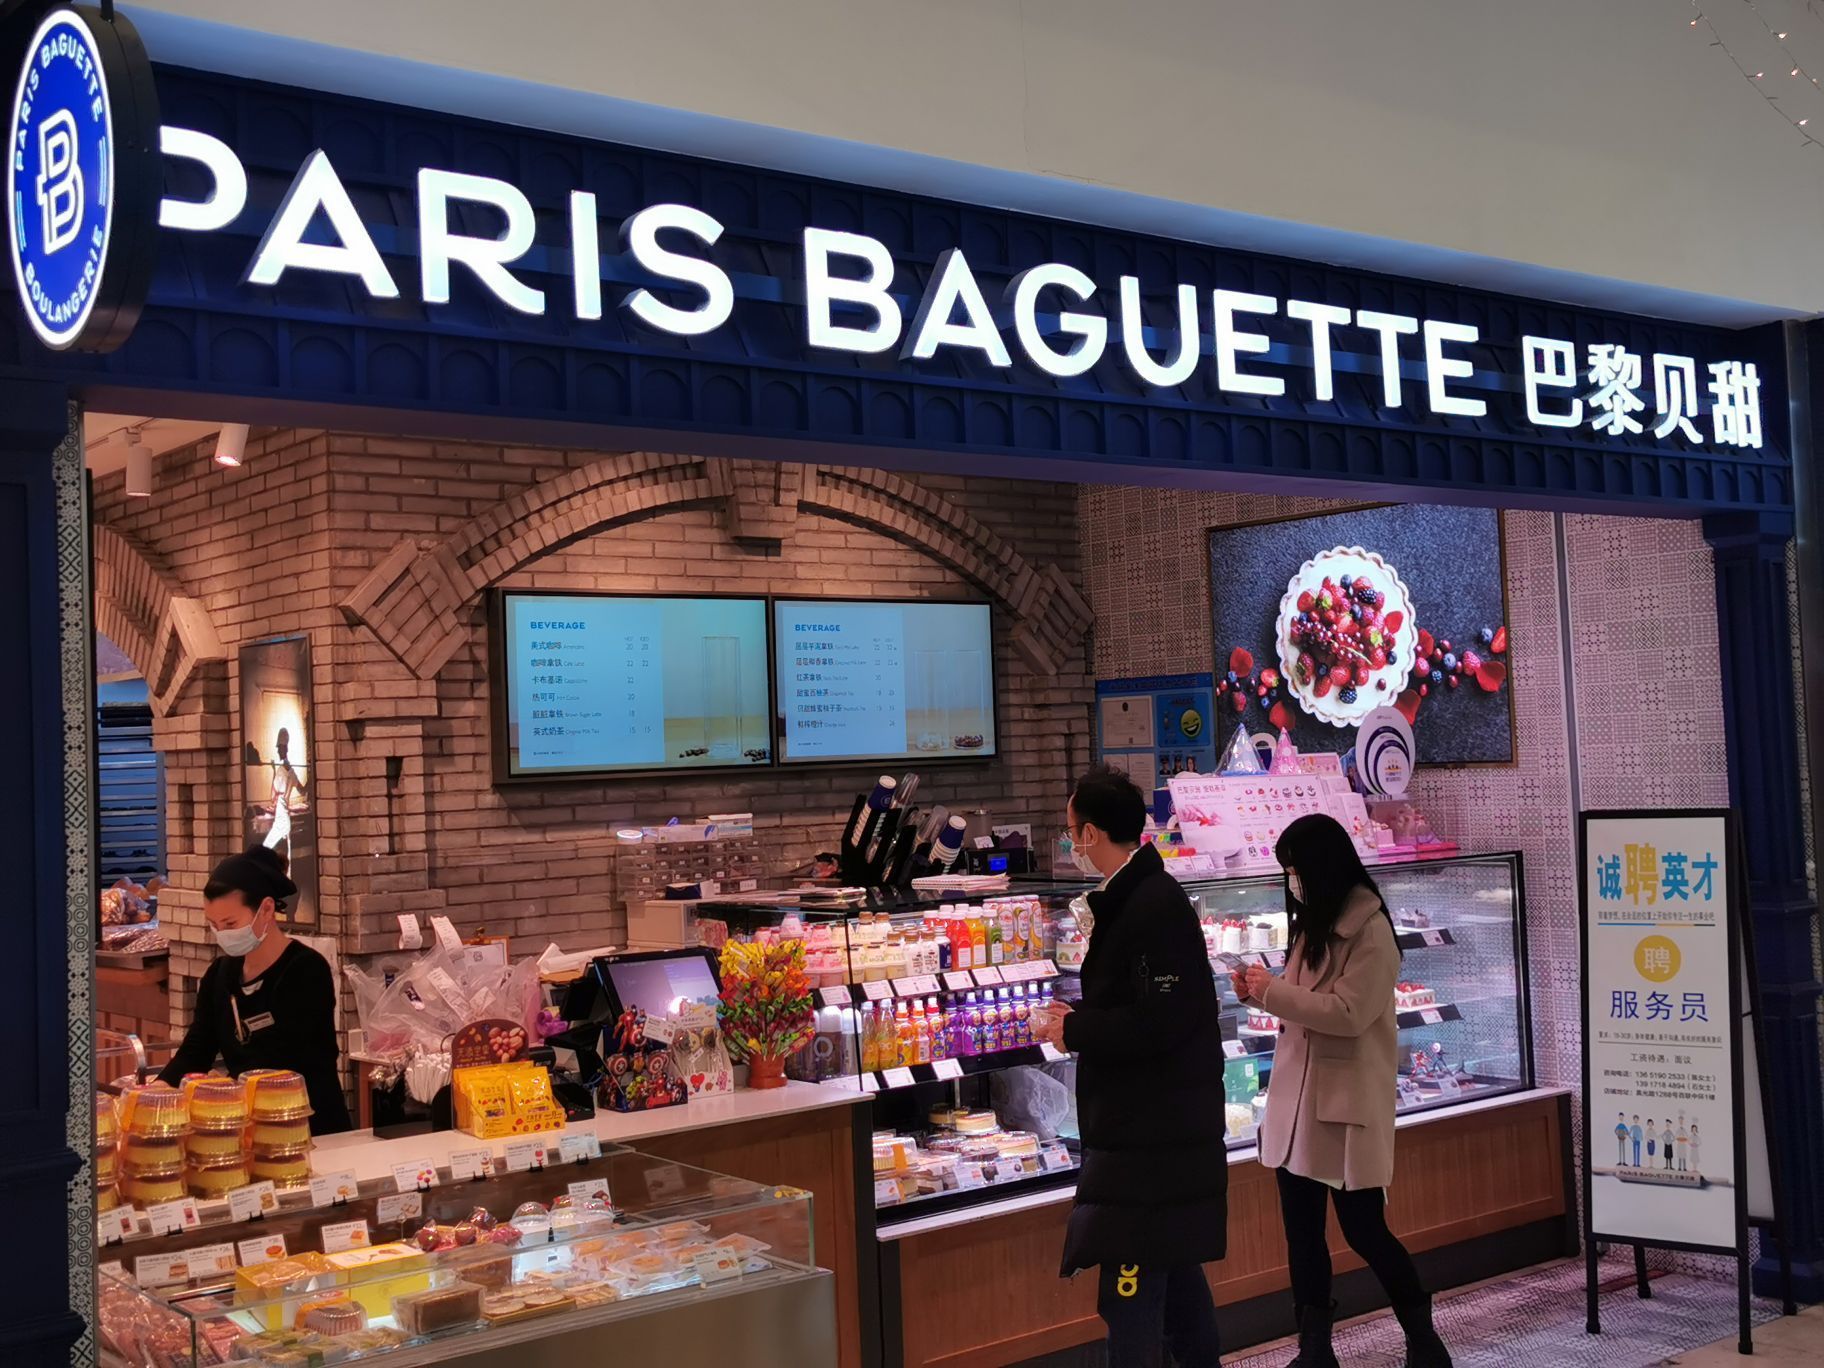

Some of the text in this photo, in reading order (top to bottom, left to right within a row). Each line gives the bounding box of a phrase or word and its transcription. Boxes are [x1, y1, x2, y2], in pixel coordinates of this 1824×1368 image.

[16, 33, 103, 171] PARIS BAGUETTE
[25, 224, 103, 323] BOULANGERIE
[158, 125, 1488, 418] PARIS BAGUETTE
[1522, 335, 1764, 450] 巴黎贝甜
[530, 621, 586, 630] BEVERAGE
[794, 624, 841, 632] BEVERAGE
[531, 641, 562, 650] 美式咖啡
[530, 659, 562, 667] 咖啡拿铁
[531, 676, 563, 685] 卡布基诺
[532, 692, 556, 702] 热可可
[533, 726, 564, 736] 英式奶茶
[1596, 842, 1719, 906] 诚聘英才
[1643, 946, 1671, 974] 聘
[1609, 990, 1710, 1023] 服务员
